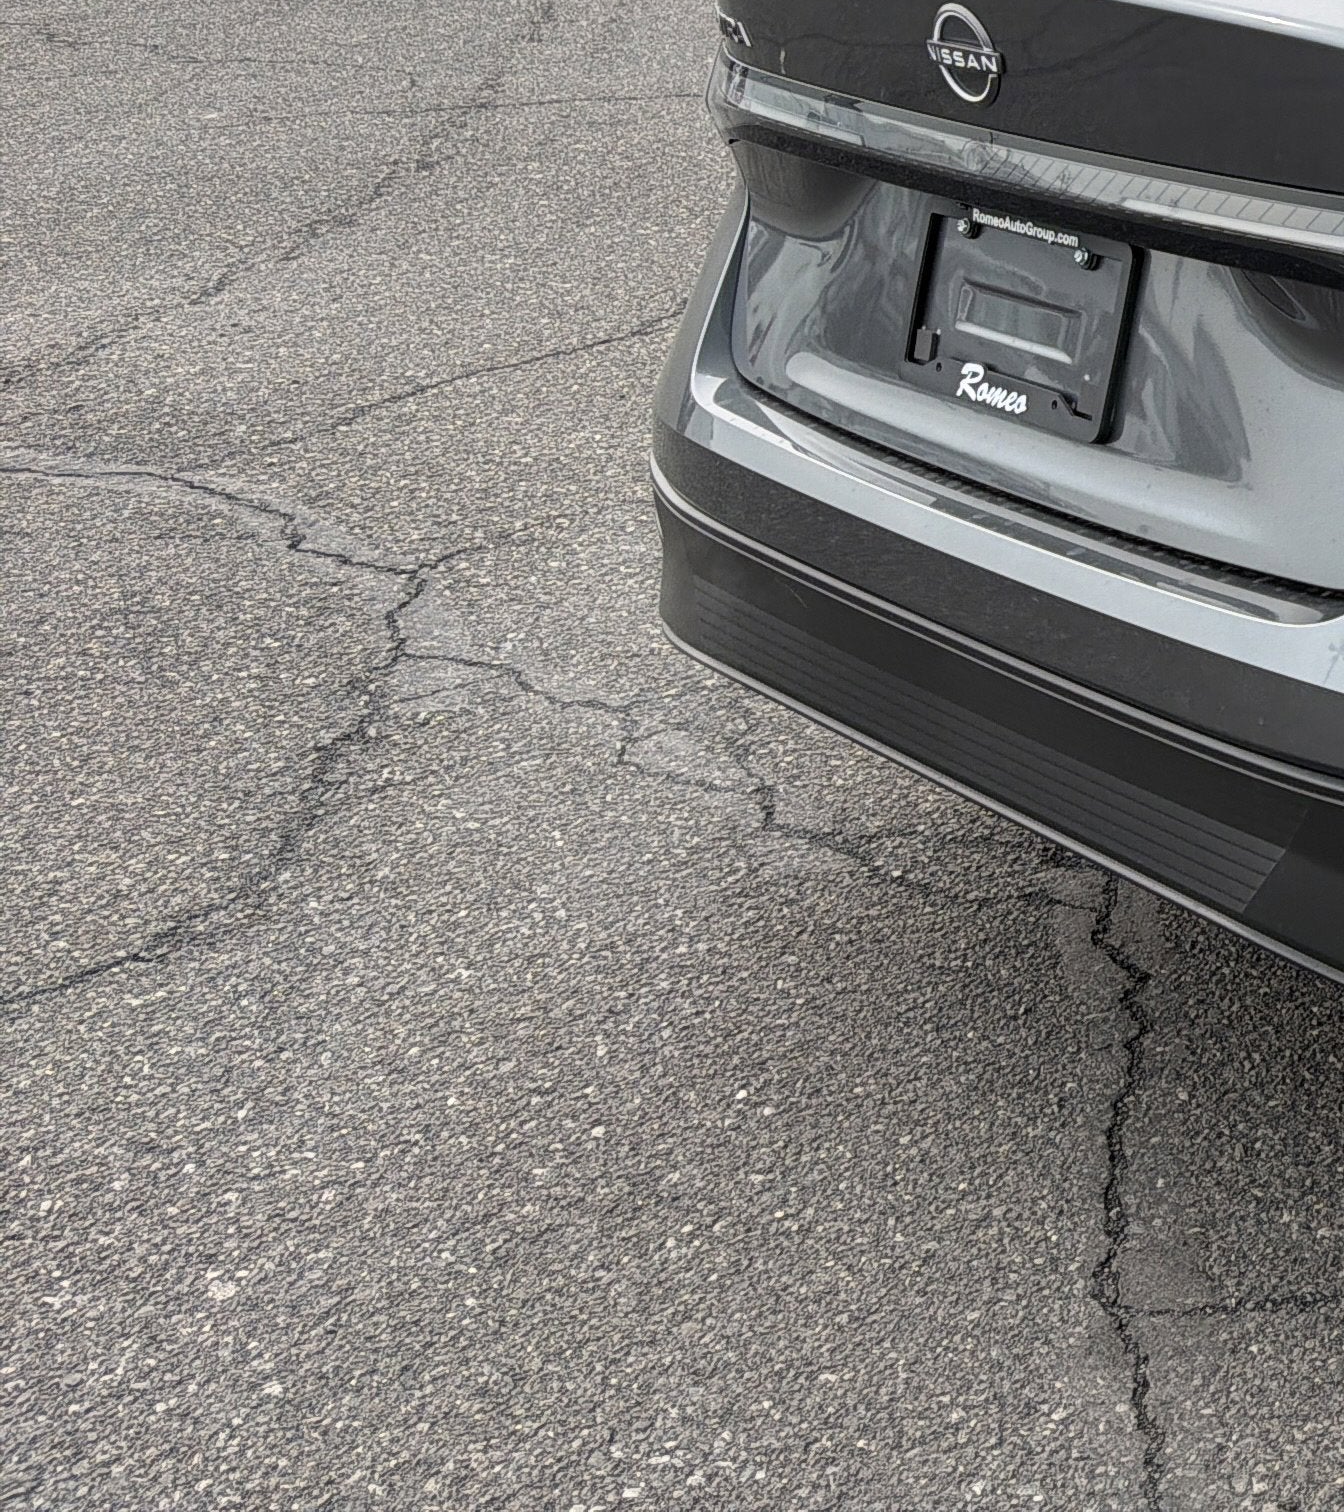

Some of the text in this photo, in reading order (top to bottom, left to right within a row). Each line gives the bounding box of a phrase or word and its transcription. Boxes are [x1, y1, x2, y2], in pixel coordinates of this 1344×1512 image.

[927, 44, 998, 73] NISSAN
[972, 208, 1079, 247] RomeoAutoGroup.com
[956, 362, 1028, 415] Romeo
